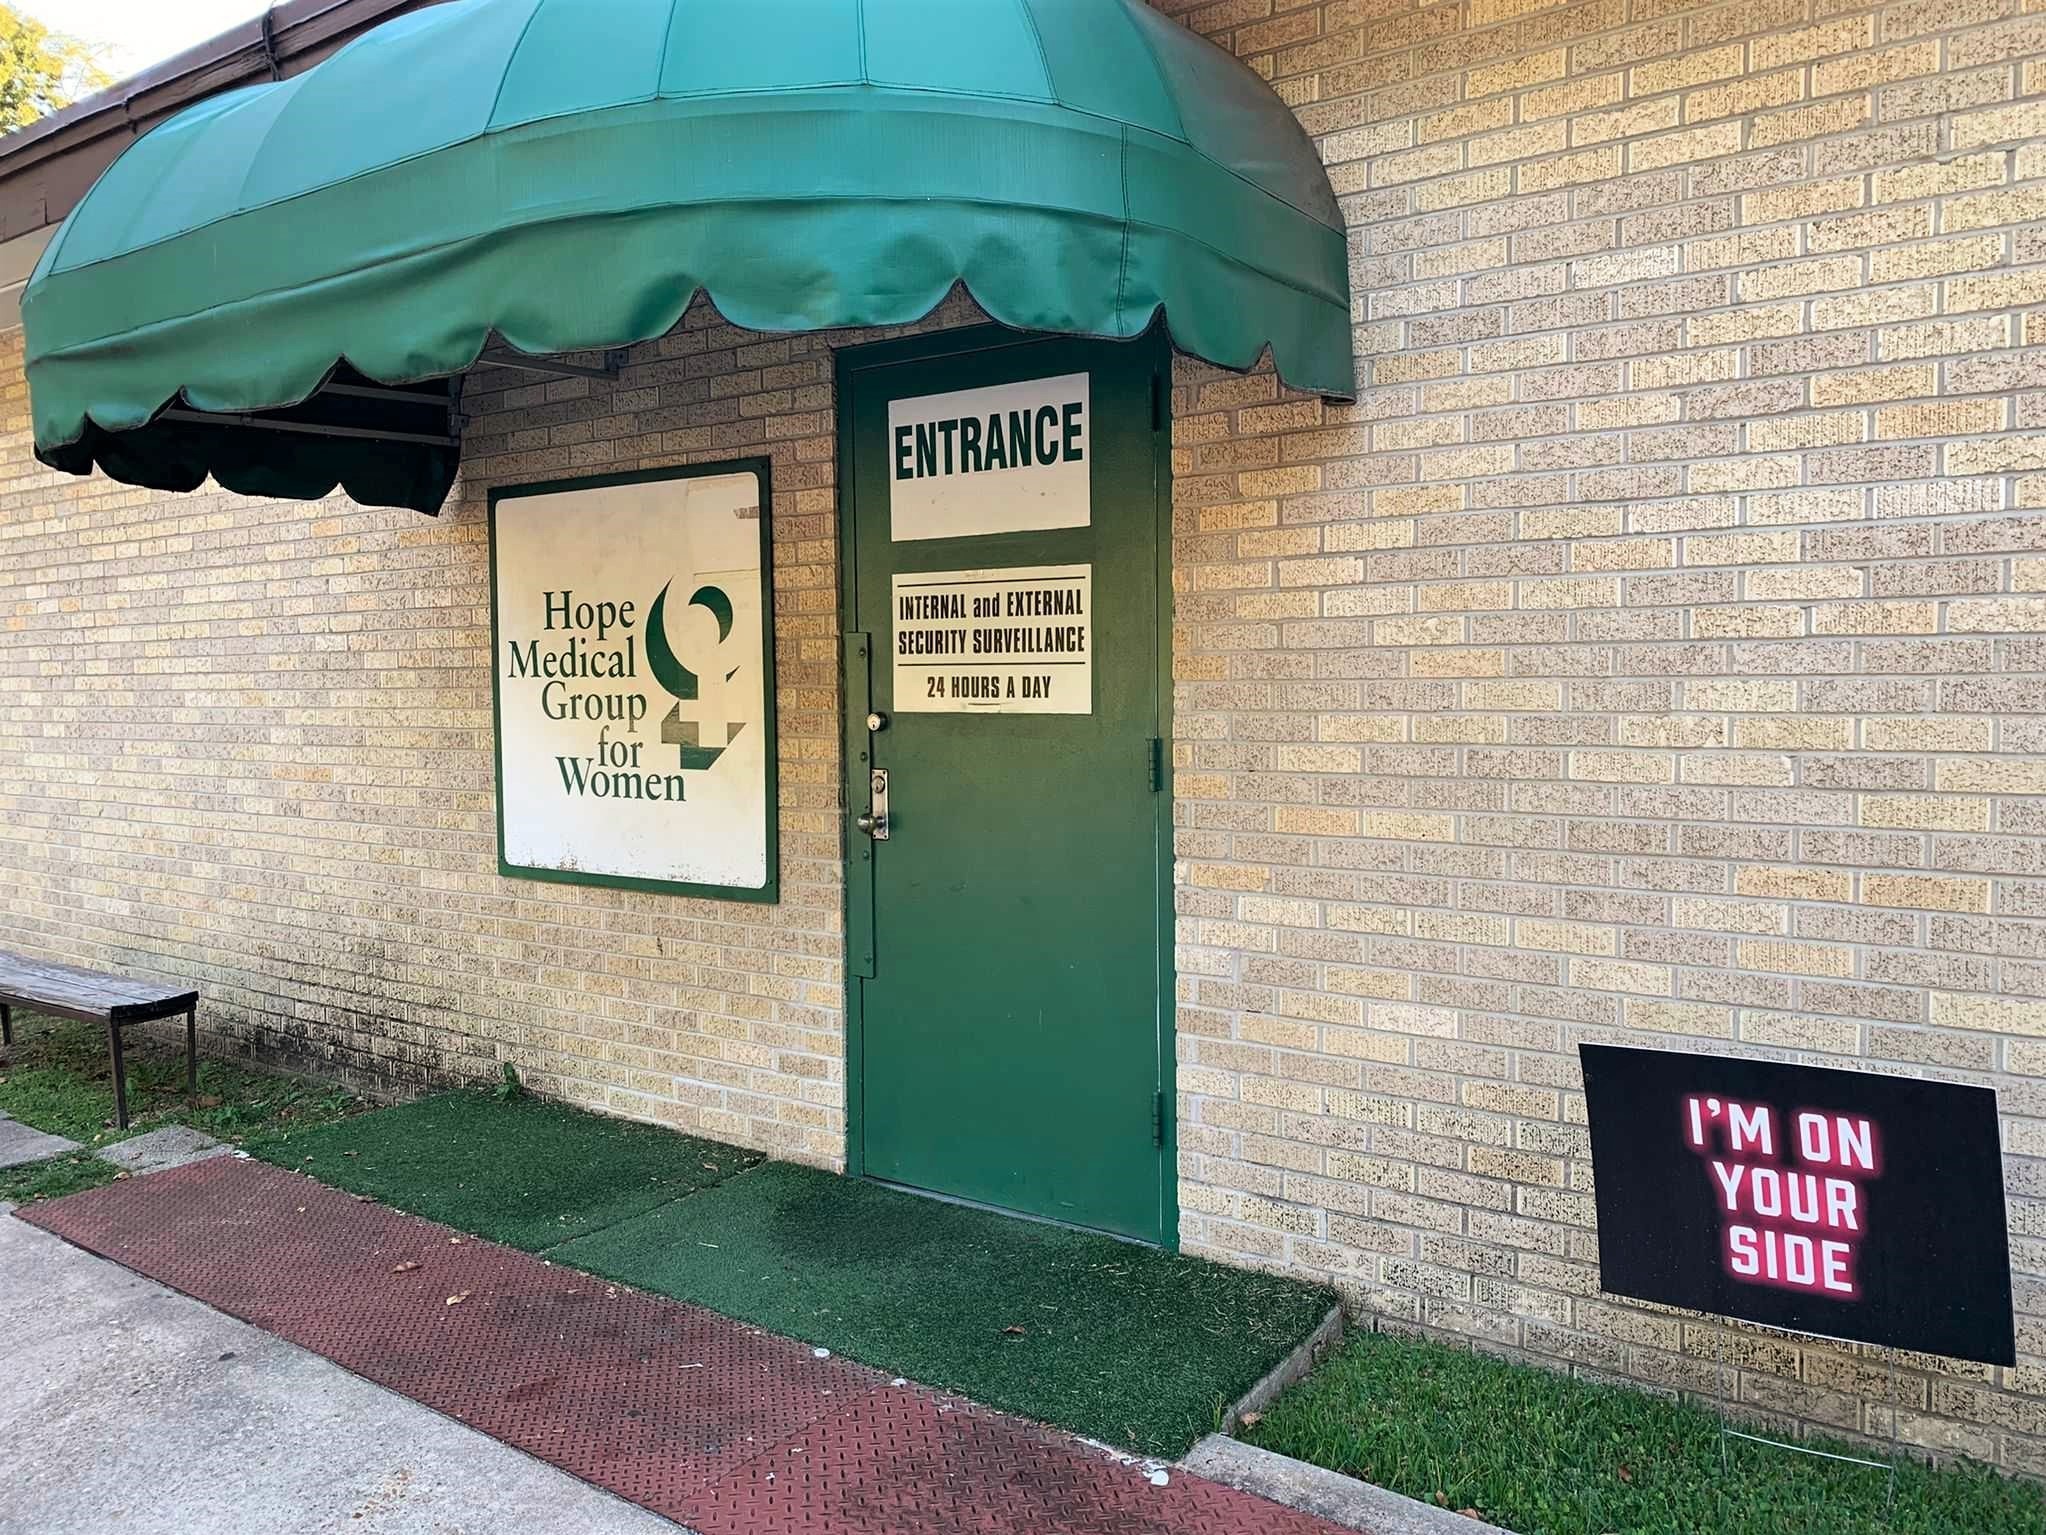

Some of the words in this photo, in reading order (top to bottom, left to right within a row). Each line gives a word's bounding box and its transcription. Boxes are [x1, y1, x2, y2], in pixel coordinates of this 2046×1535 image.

[895, 402, 1083, 480] ENTRANCE
[543, 591, 635, 641] Hope
[899, 594, 967, 620] INTERNAL
[973, 592, 1000, 618] and
[1007, 589, 1083, 617] EXTERNAL
[508, 636, 637, 678] Medical
[898, 629, 967, 655] SECURITY
[973, 626, 1085, 654] SURVEILLANCE
[542, 681, 647, 732] Group
[927, 676, 945, 698] 24
[951, 676, 1000, 698] HOURS
[1006, 676, 1016, 698] A
[1022, 676, 1051, 698] DAY
[598, 725, 643, 768] for
[555, 756, 687, 802] Women
[1688, 1098, 1773, 1155] I'M
[1798, 1113, 1874, 1169] ON
[1712, 1161, 1858, 1231] YOUR
[1729, 1225, 1853, 1292] SIDE
